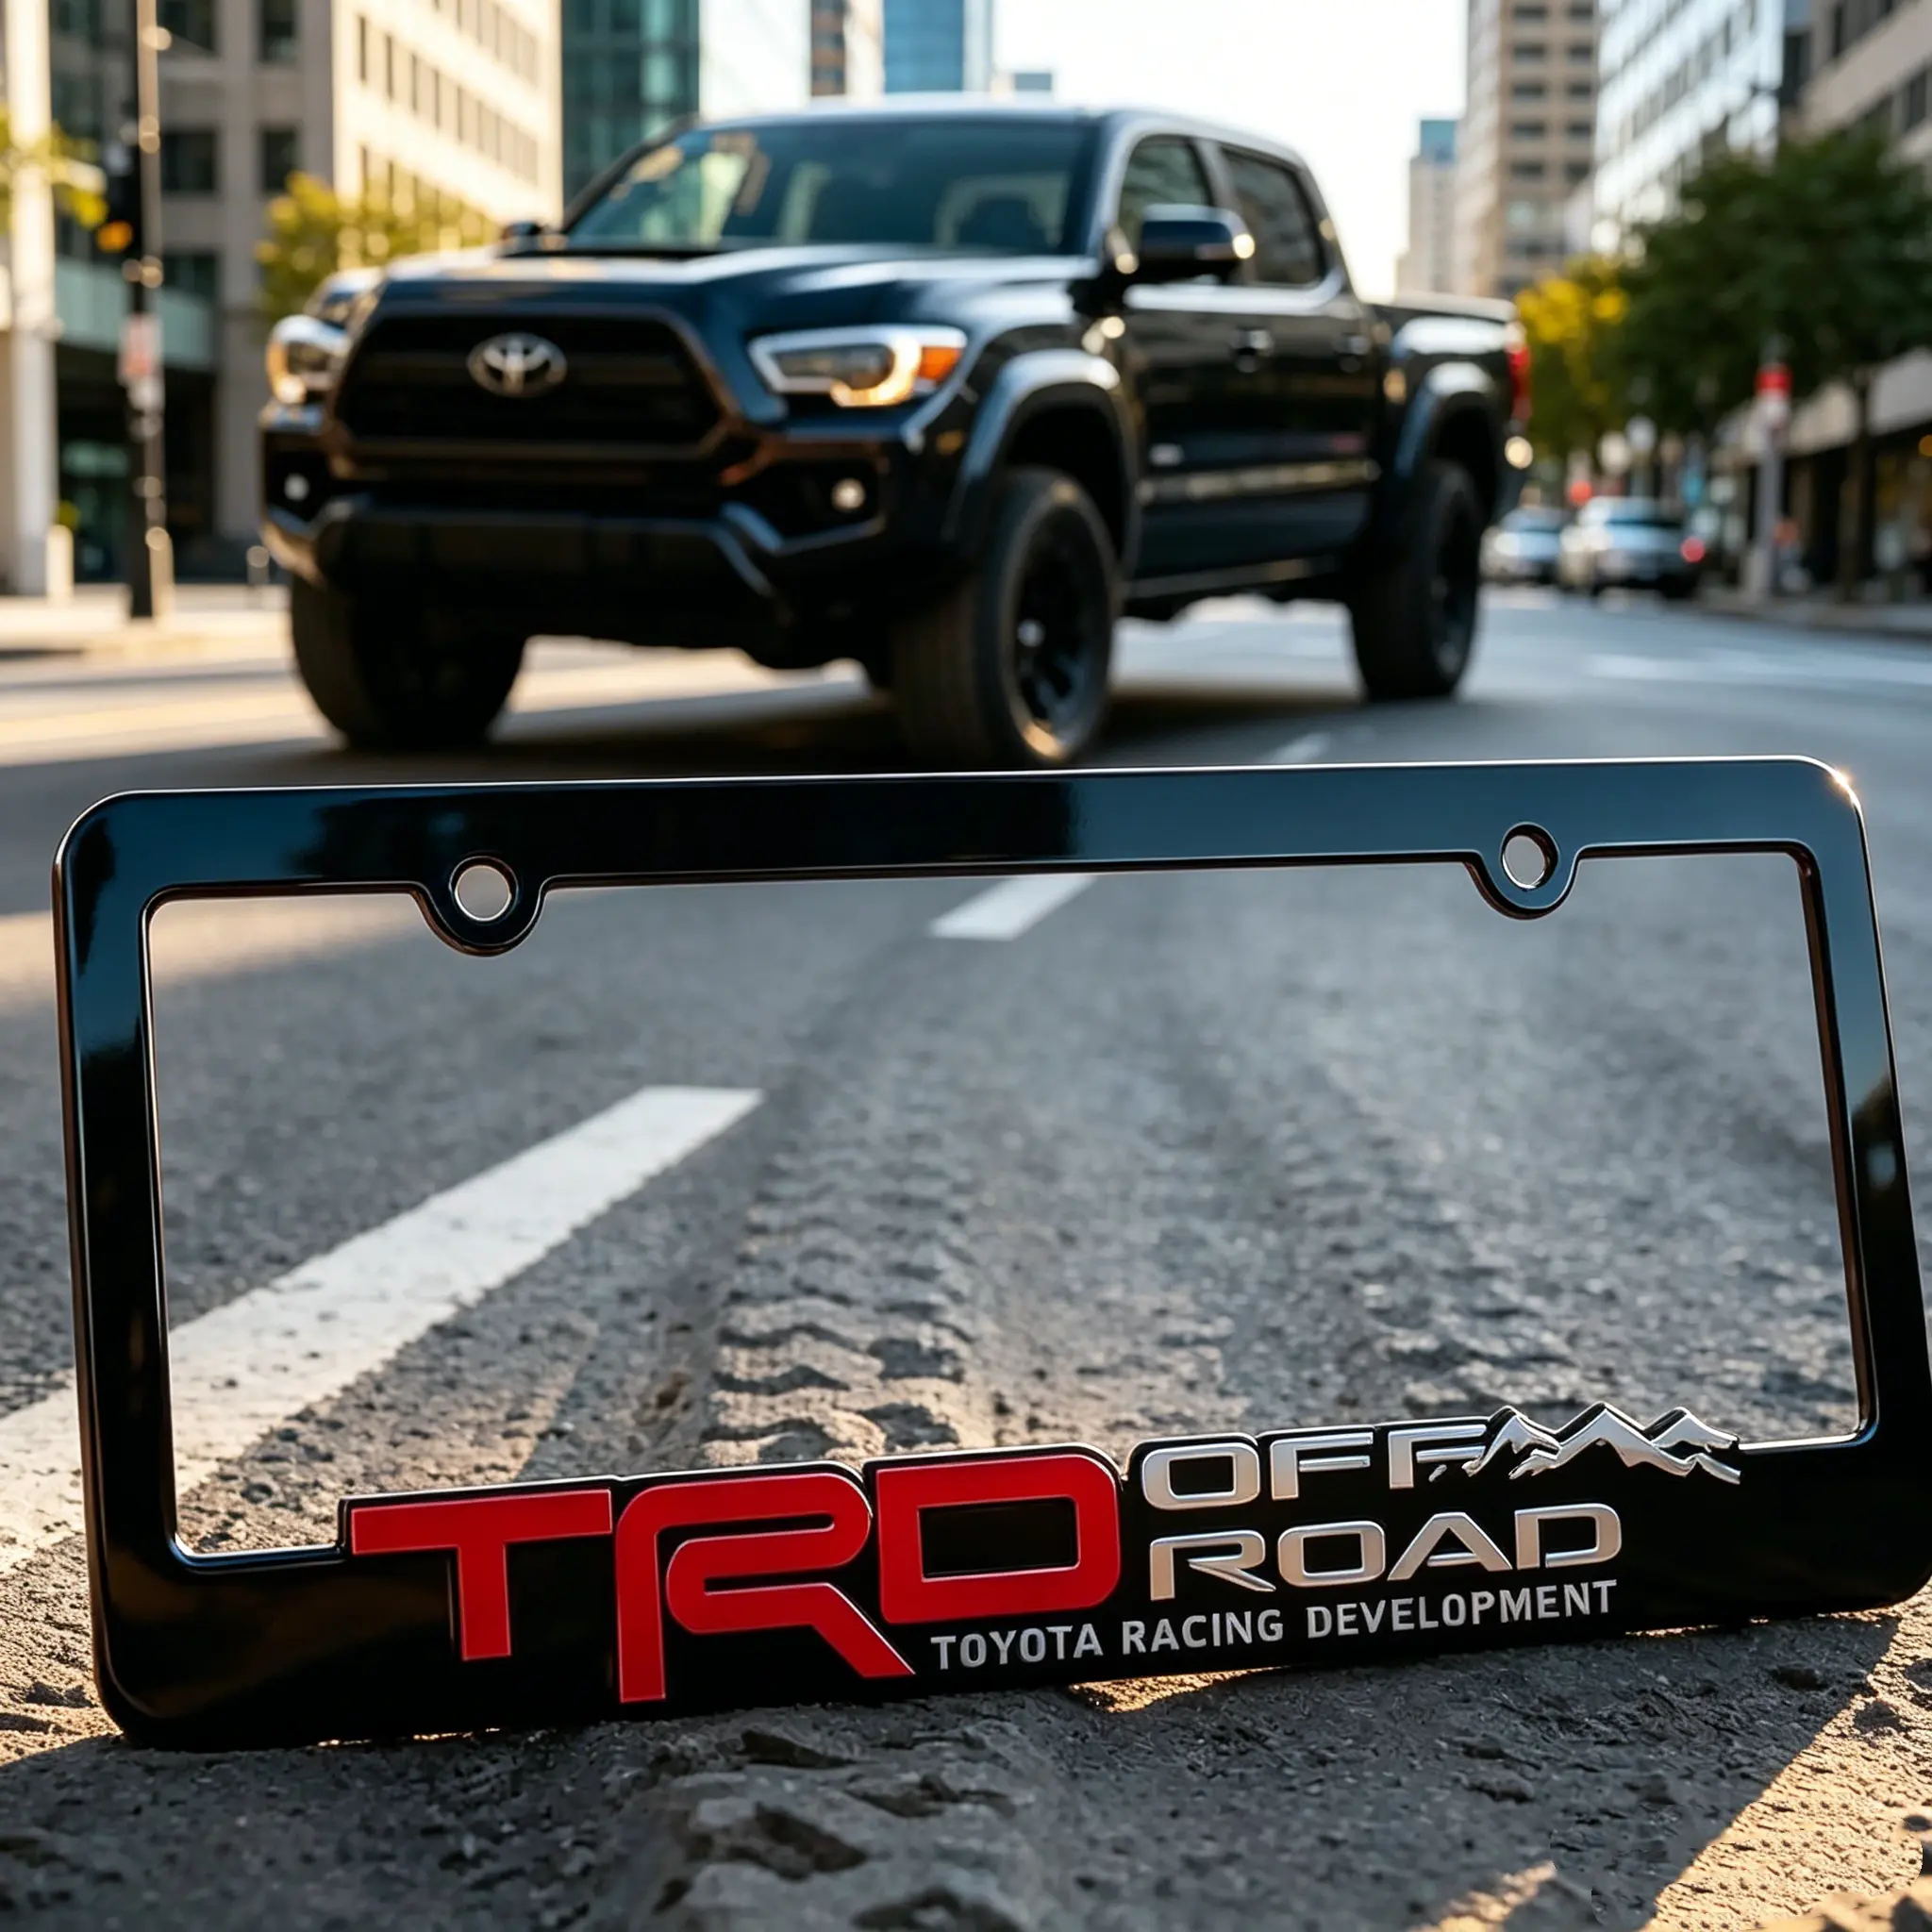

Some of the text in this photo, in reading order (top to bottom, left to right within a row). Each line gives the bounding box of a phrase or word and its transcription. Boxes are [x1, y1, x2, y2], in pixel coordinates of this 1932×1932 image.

[1141, 1424, 1488, 1509] OFF
[350, 1454, 1122, 1704] TRD
[1149, 1504, 1622, 1601] ROAD
[930, 1580, 1618, 1670] TOYOTA RACING DEVELOPMENT
